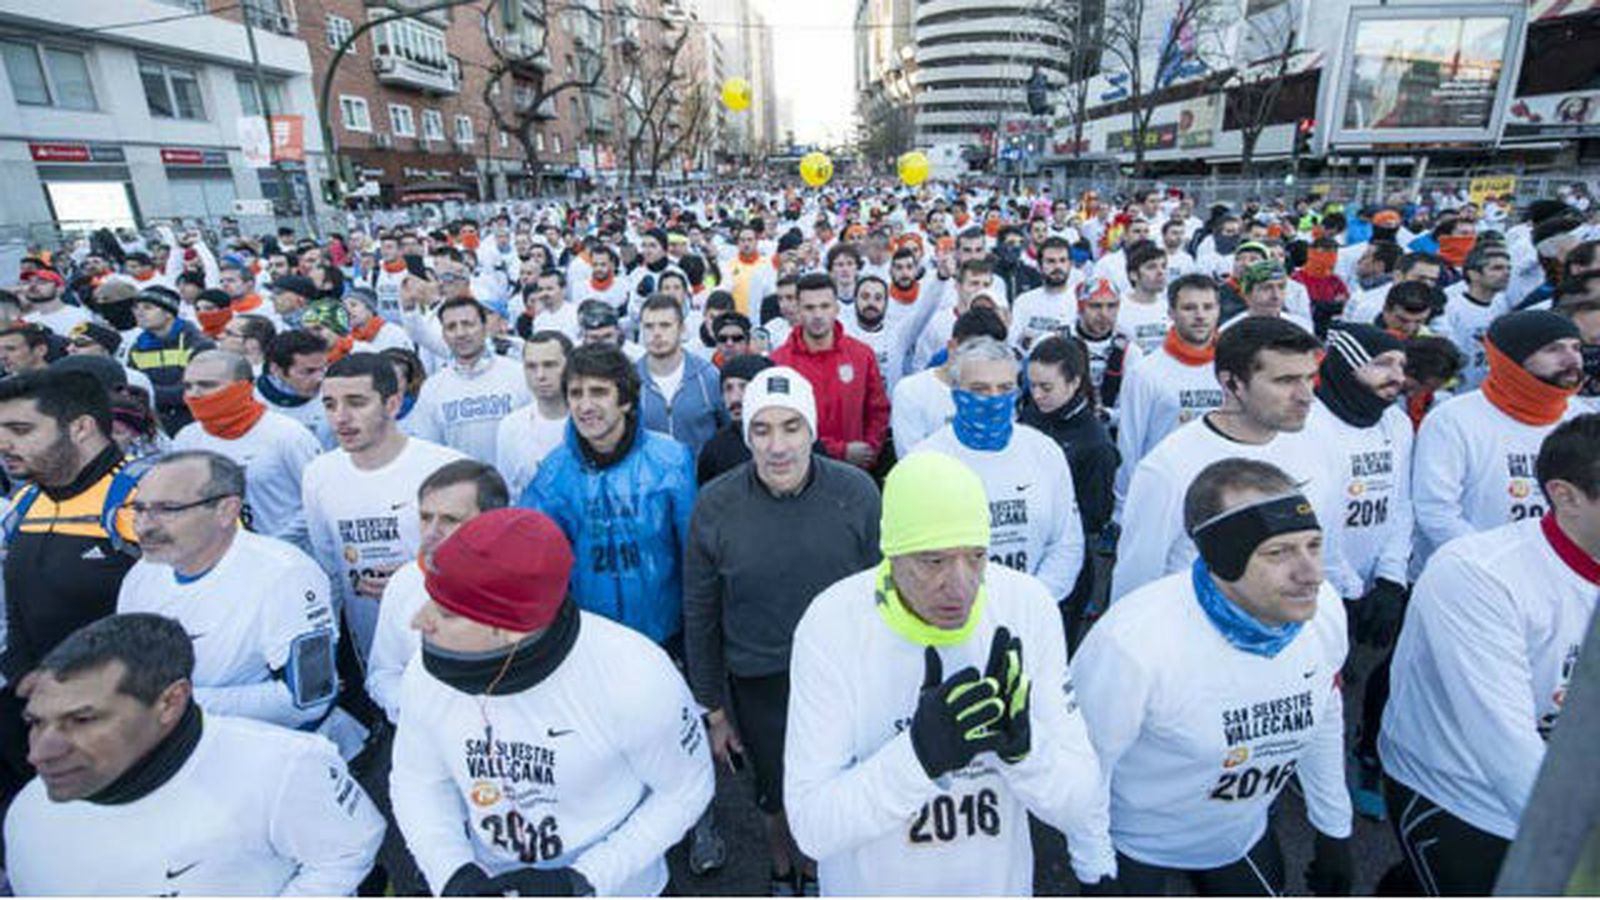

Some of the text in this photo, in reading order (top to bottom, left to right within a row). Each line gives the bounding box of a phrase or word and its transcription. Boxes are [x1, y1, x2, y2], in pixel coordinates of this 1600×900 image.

[1346, 496, 1388, 527] 2016
[1222, 690, 1313, 727] SAN SILVESTRE
[1224, 709, 1314, 747] VALLECANA
[494, 739, 556, 766] SILVESTRE
[909, 788, 1001, 843] 2016
[481, 810, 563, 863] 2016
